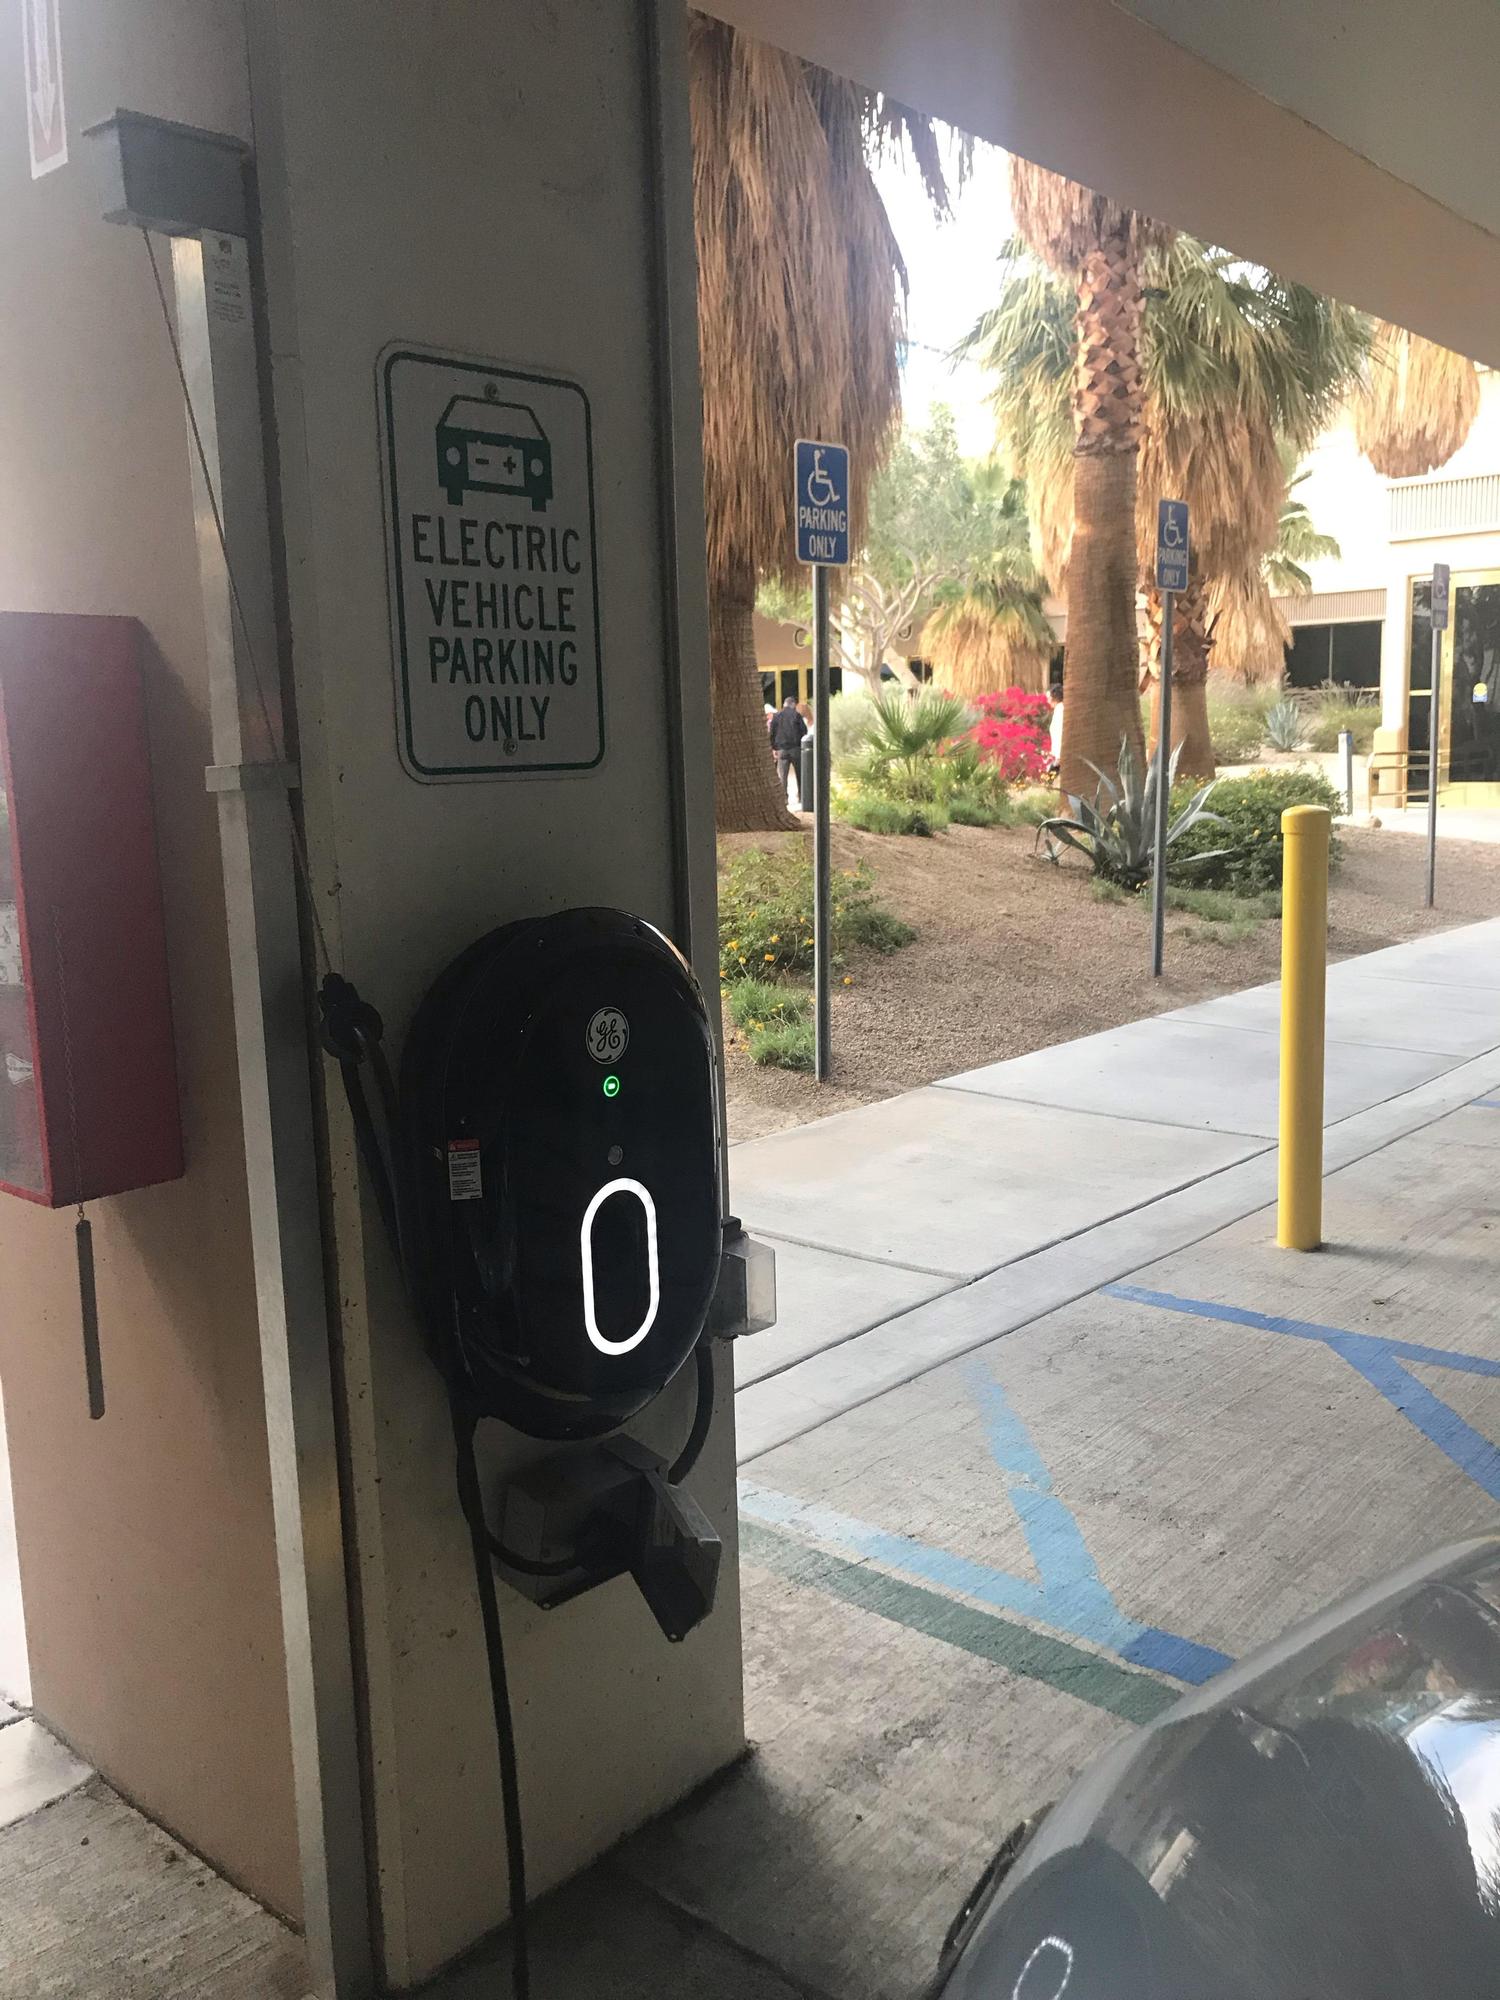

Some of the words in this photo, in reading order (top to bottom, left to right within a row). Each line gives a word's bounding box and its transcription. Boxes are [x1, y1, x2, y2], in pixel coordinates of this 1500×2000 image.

[799, 506, 847, 532] PARKING
[412, 514, 581, 574] ELECTRIC
[809, 534, 837, 558] ONLY
[425, 578, 577, 632] VEHICLE
[428, 636, 578, 686] PARKING
[465, 695, 550, 742] ONLY
